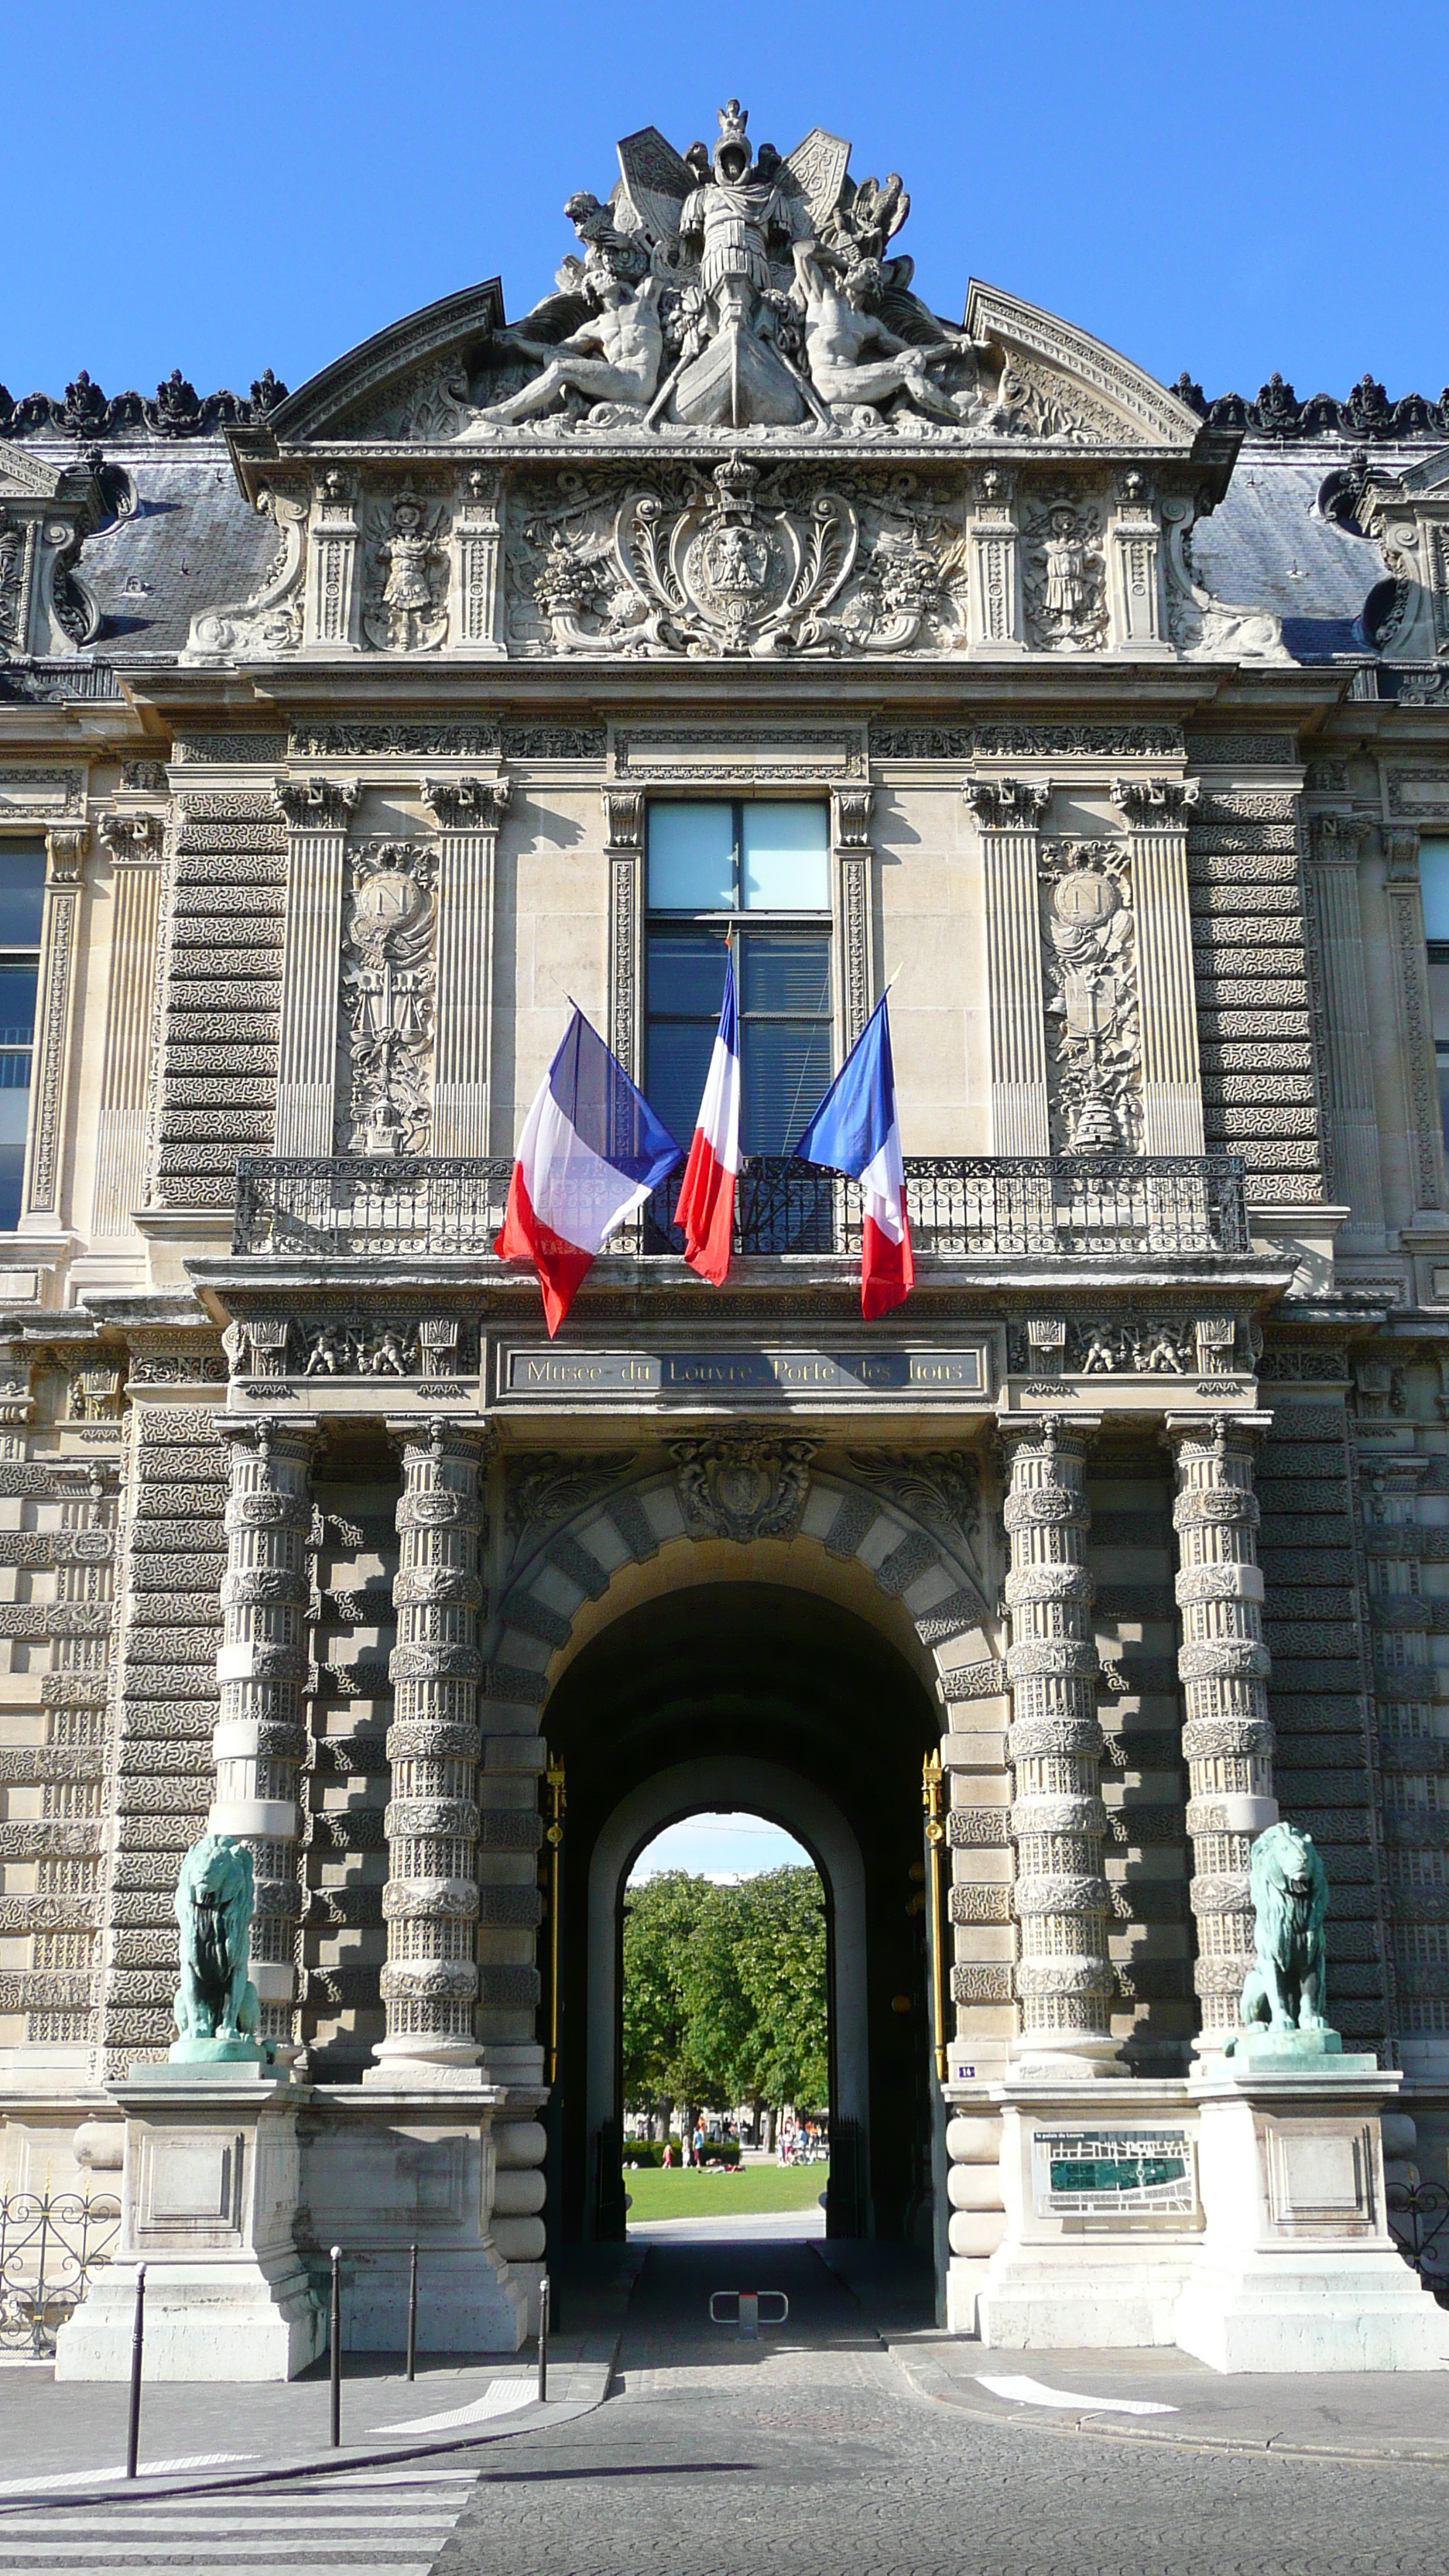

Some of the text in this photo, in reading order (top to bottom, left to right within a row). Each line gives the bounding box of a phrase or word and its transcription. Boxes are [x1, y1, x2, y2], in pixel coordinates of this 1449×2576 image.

[375, 884, 408, 916] N
[1071, 884, 1101, 914] N
[621, 1360, 649, 1381] du
[670, 1359, 752, 1382] Louvre
[774, 1359, 835, 1381] Porte
[853, 1360, 890, 1381] des
[909, 1359, 963, 1381] lions
